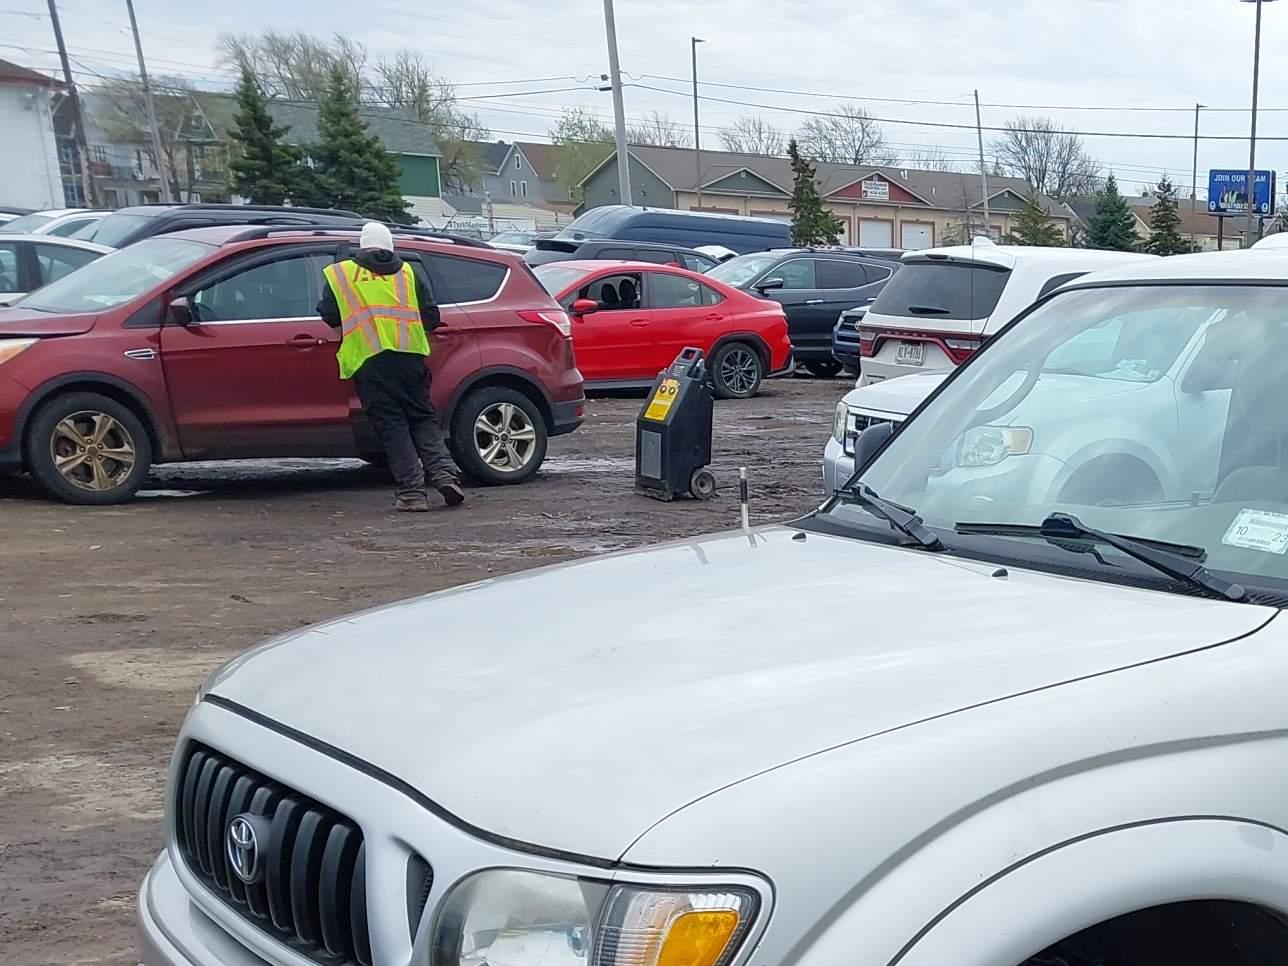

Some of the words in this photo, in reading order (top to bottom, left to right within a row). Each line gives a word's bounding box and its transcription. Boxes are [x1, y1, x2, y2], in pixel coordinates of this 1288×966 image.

[1214, 174, 1230, 182] JOIN
[1231, 174, 1246, 183] OUR
[1248, 175, 1267, 183] AM
[1236, 526, 1249, 536] 10
